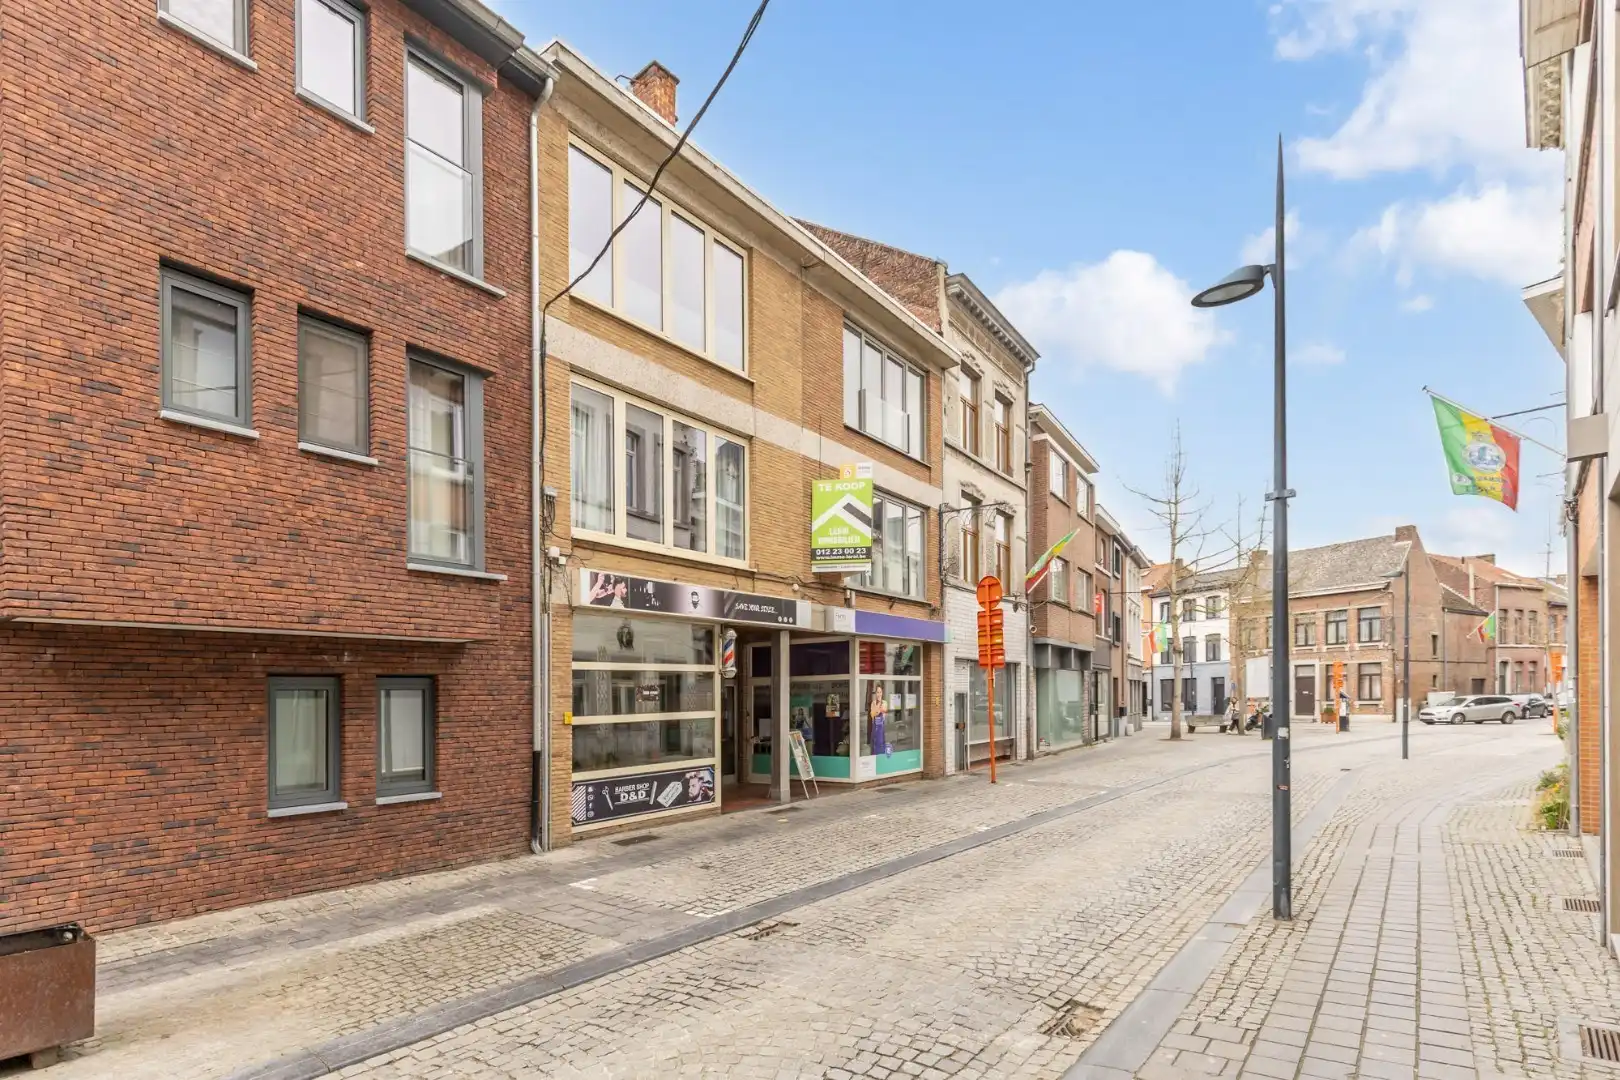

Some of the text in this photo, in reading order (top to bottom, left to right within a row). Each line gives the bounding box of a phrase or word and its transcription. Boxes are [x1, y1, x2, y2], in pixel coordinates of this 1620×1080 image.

[818, 481, 866, 492] TE KOOP
[614, 782, 650, 793] BARBER SHOP
[620, 790, 647, 801] D&D
